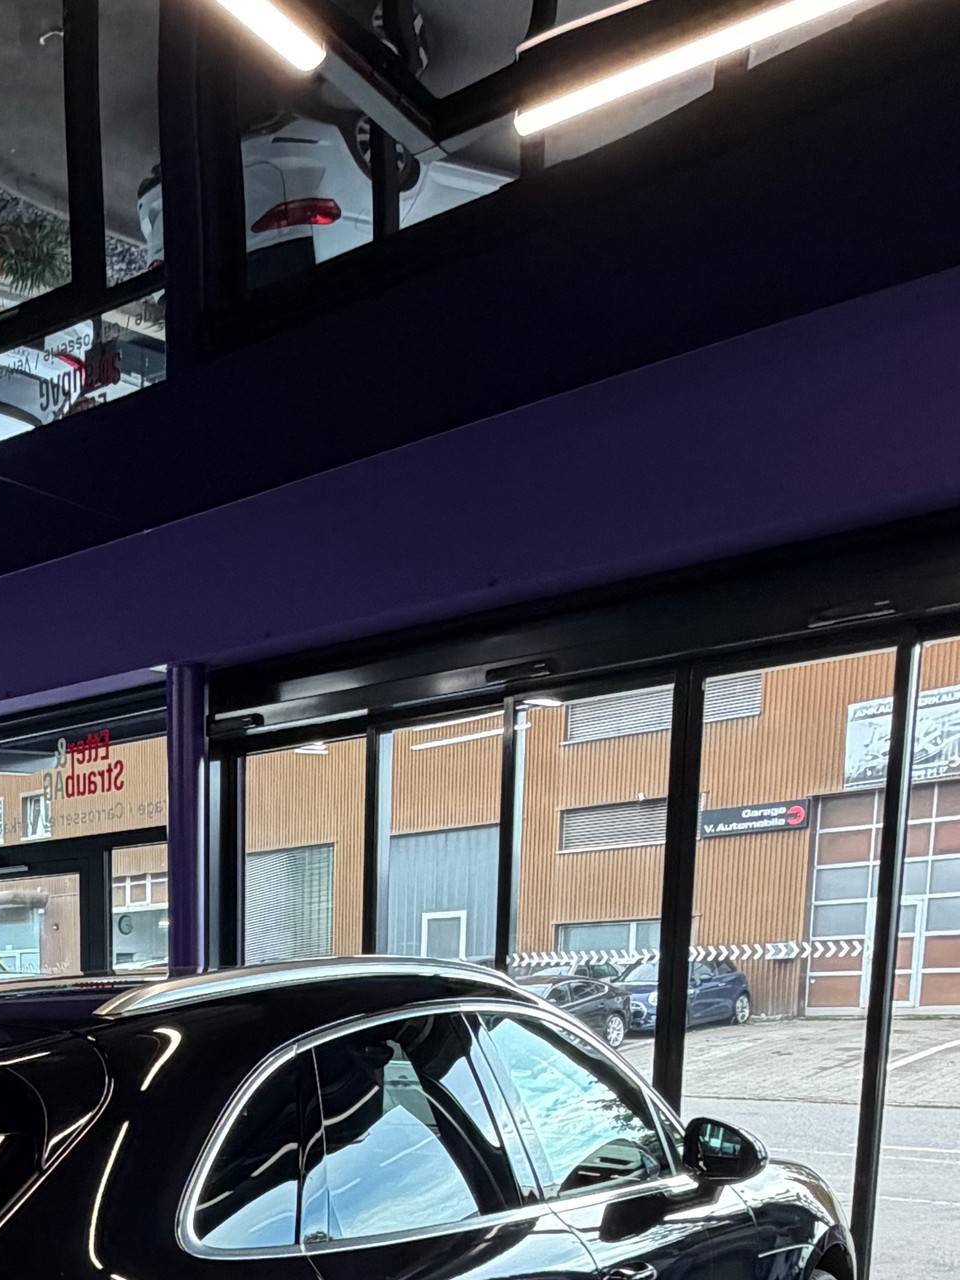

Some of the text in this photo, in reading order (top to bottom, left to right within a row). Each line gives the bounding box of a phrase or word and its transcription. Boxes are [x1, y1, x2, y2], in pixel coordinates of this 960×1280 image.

[854, 702, 893, 718] ANKAU
[741, 807, 787, 818] Garage
[703, 818, 786, 834] V. Automobile
